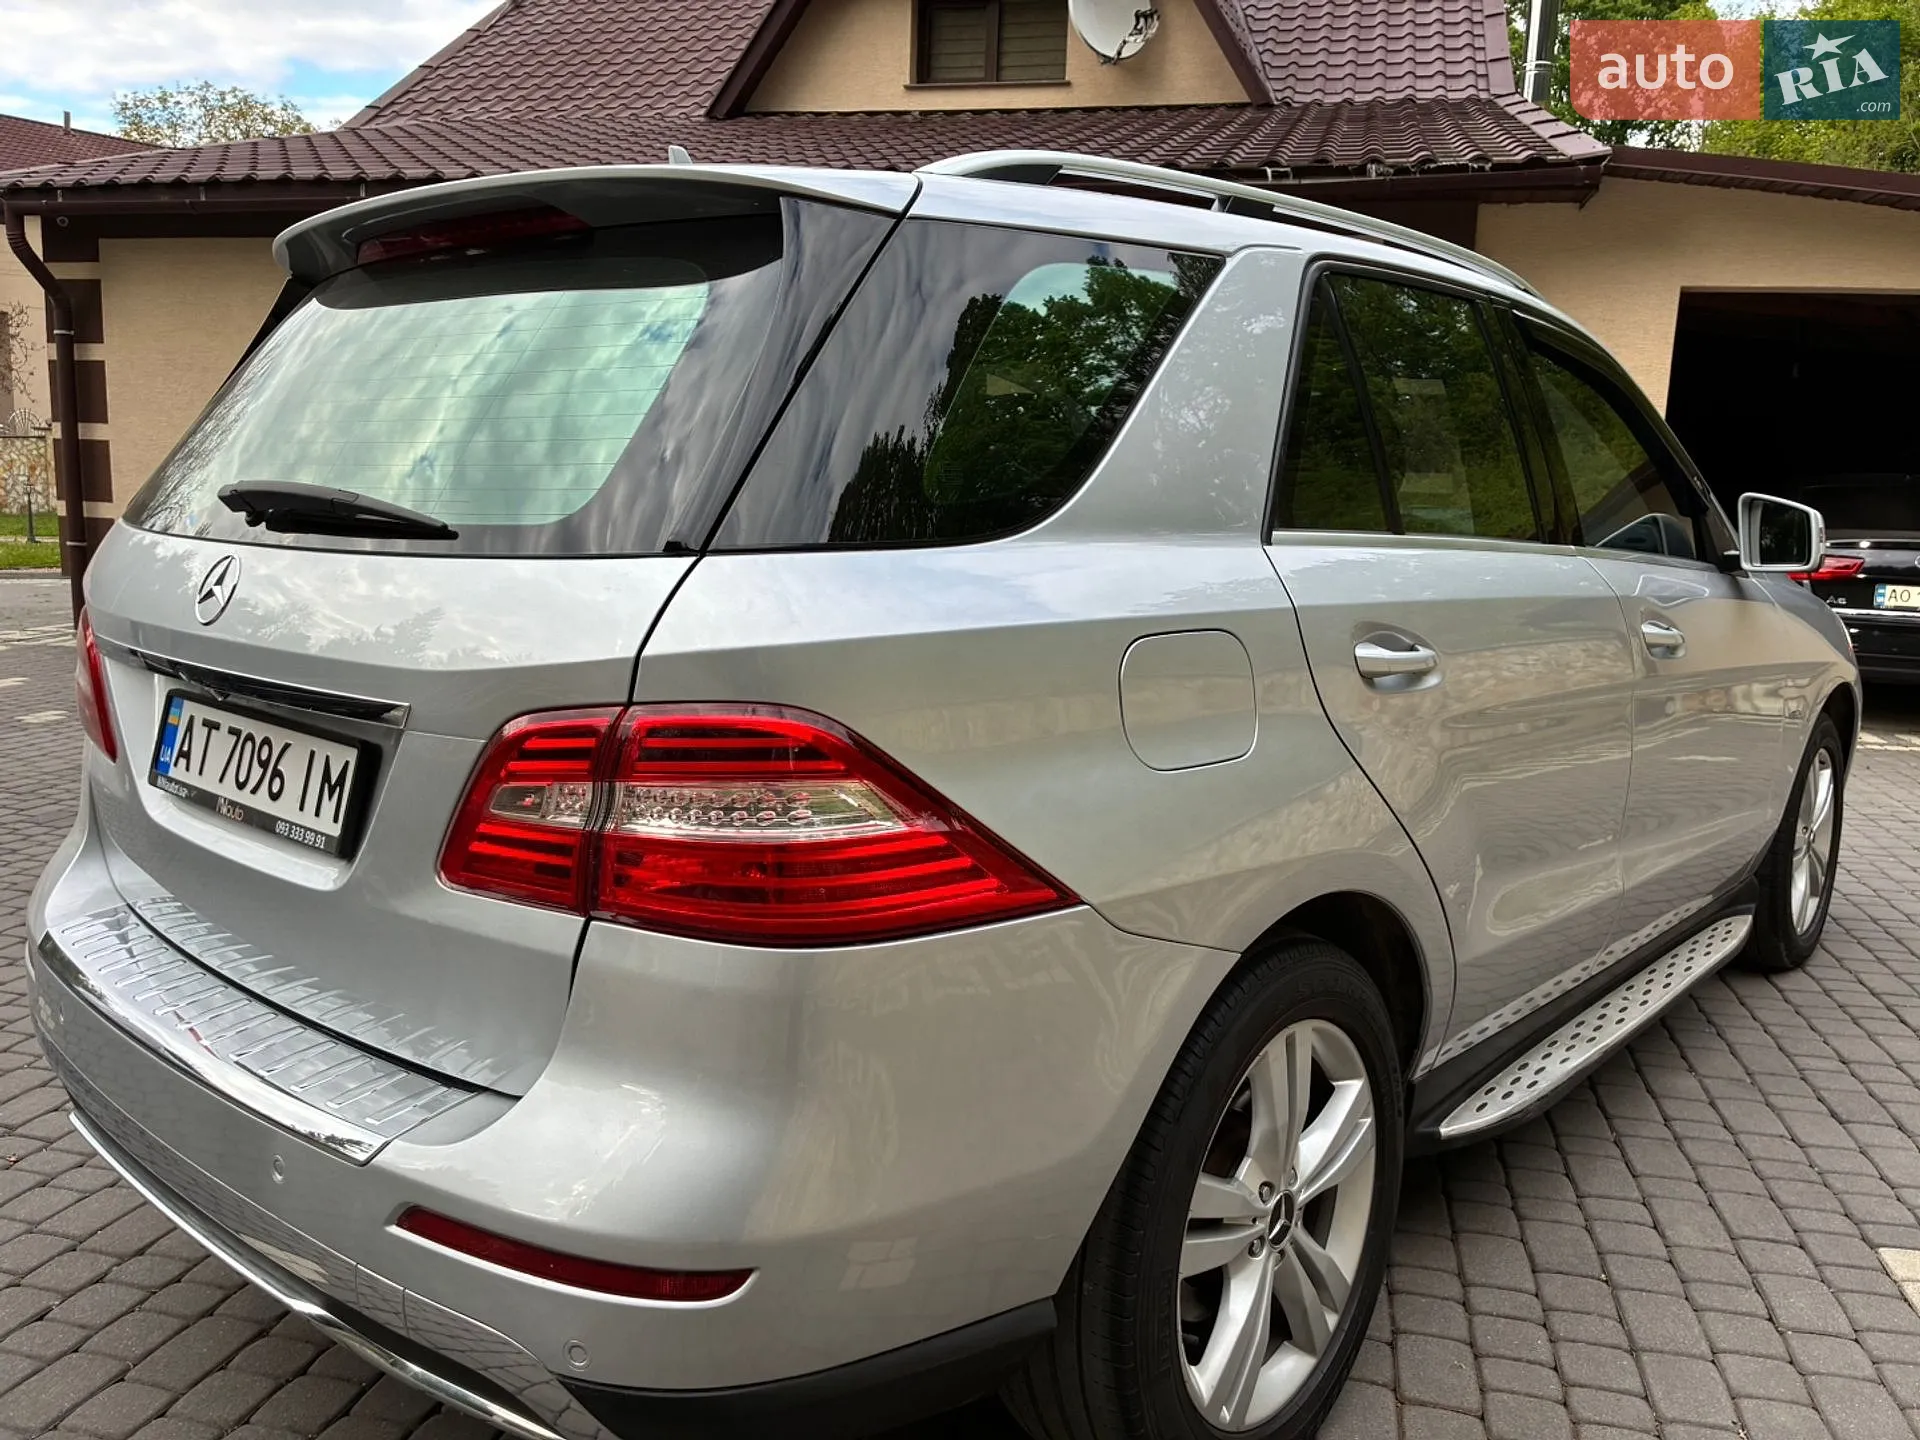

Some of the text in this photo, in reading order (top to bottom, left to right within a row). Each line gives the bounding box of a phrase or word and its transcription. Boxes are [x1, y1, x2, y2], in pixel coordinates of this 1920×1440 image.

[173, 714, 351, 824] AT 7096 IM
[275, 820, 326, 849] 093 333 99 91
